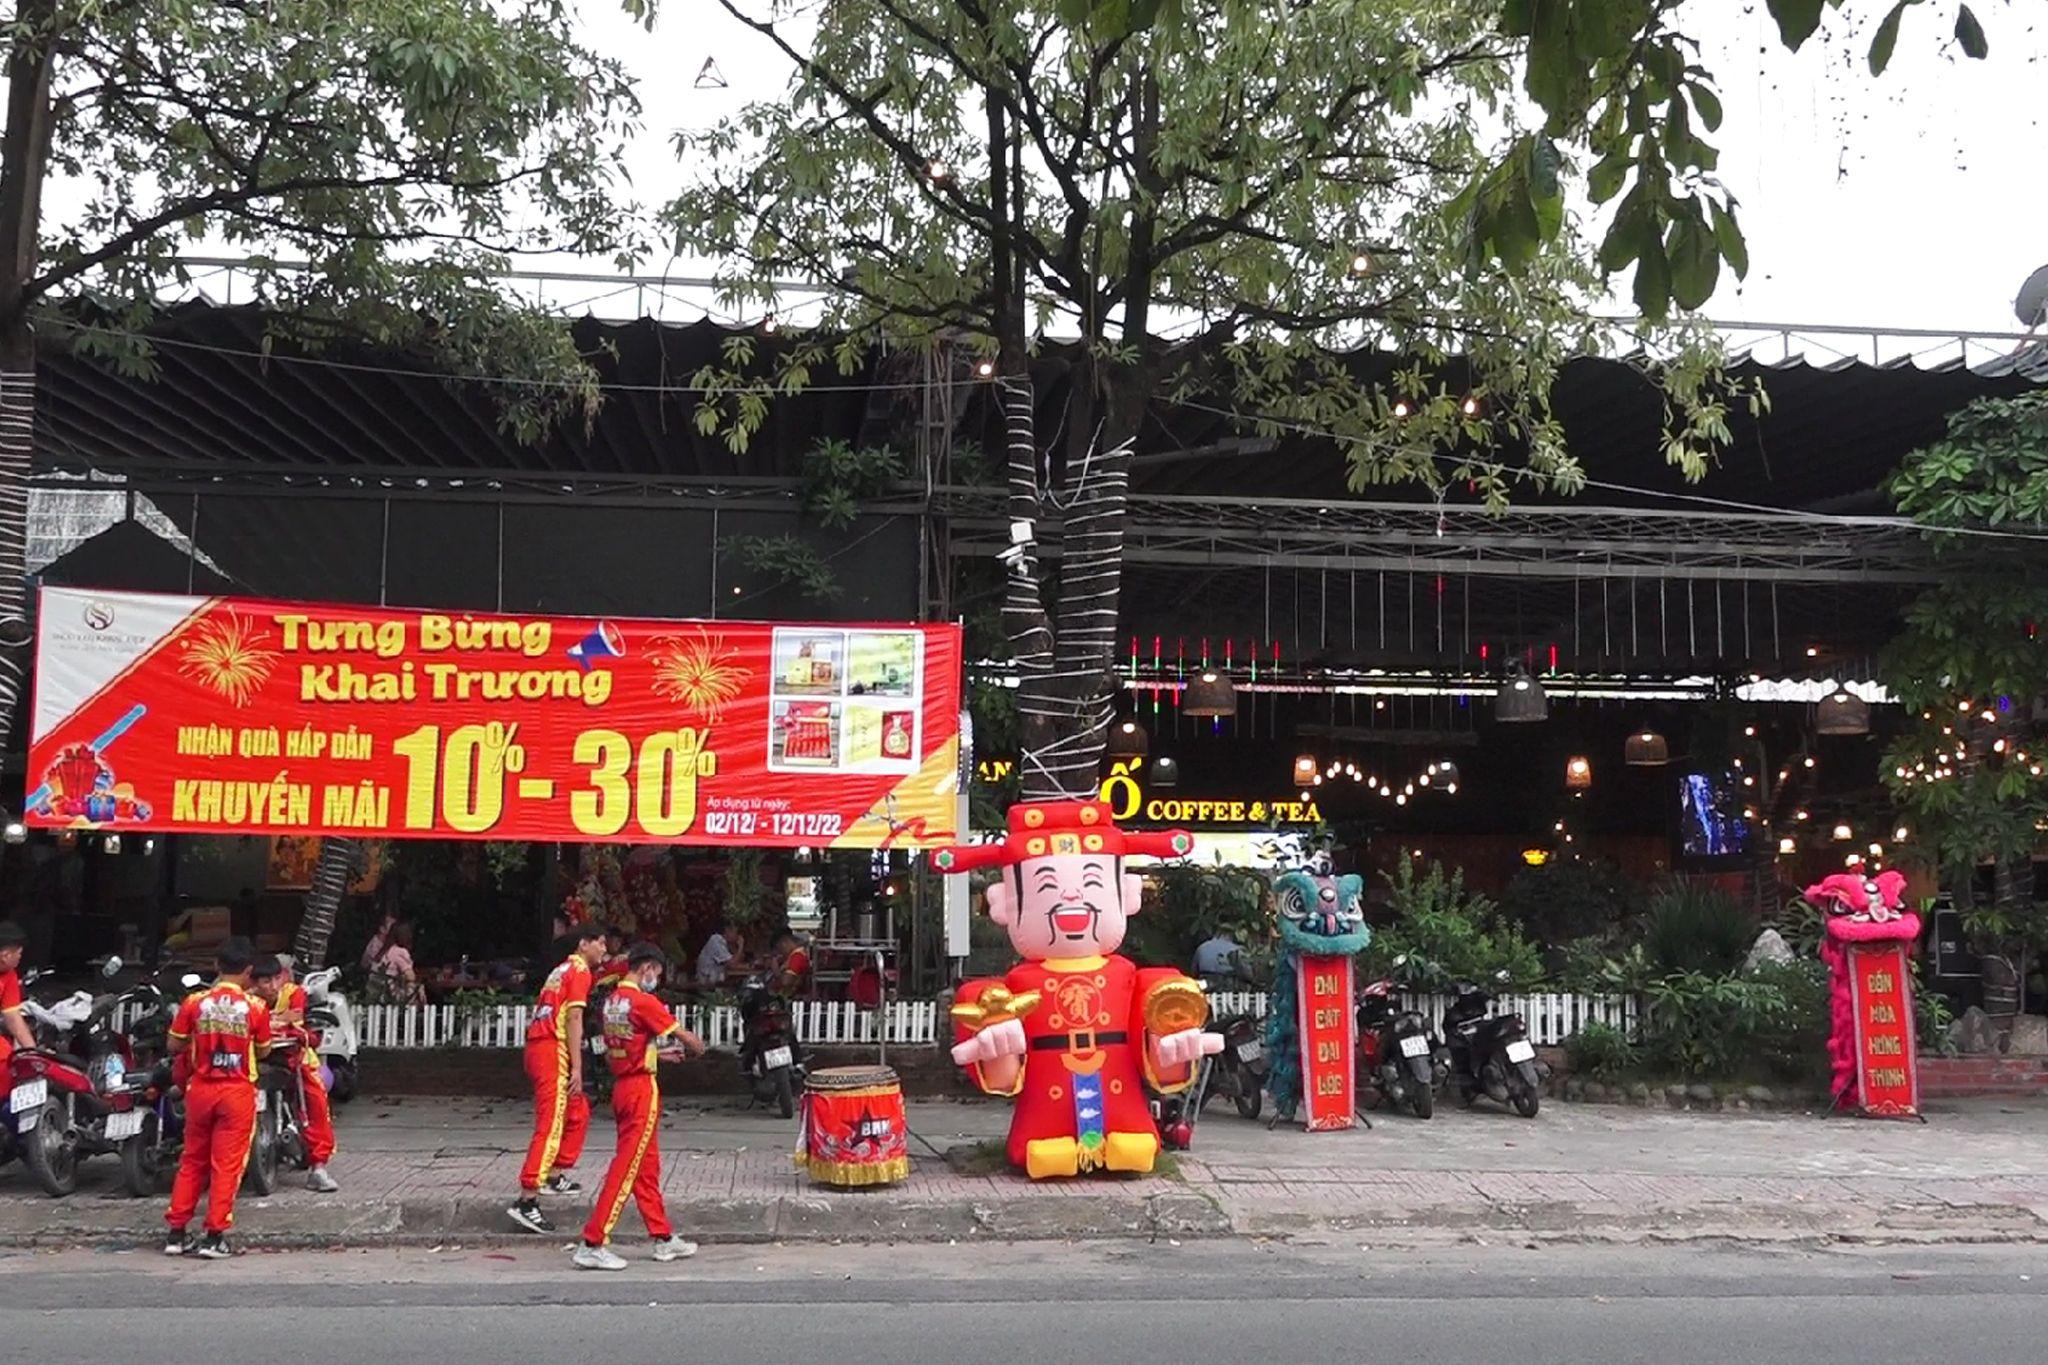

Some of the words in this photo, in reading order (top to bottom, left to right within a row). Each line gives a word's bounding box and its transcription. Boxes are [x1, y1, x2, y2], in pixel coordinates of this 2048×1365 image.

[273, 614, 406, 657] Tưng
[420, 613, 551, 656] Bừng
[301, 661, 417, 701] Khai
[424, 664, 612, 705] Trương
[177, 722, 233, 759] NHẬN
[239, 725, 280, 758] QUÀ
[286, 722, 327, 757] HẤP
[330, 725, 372, 760] DẪN
[172, 769, 311, 825] KHUYẾN
[321, 778, 390, 828] MÃI
[1147, 800, 1245, 821] COFFEE
[1248, 801, 1266, 821] &
[1271, 802, 1321, 822] TEA
[772, 814, 842, 836] 12/12/22
